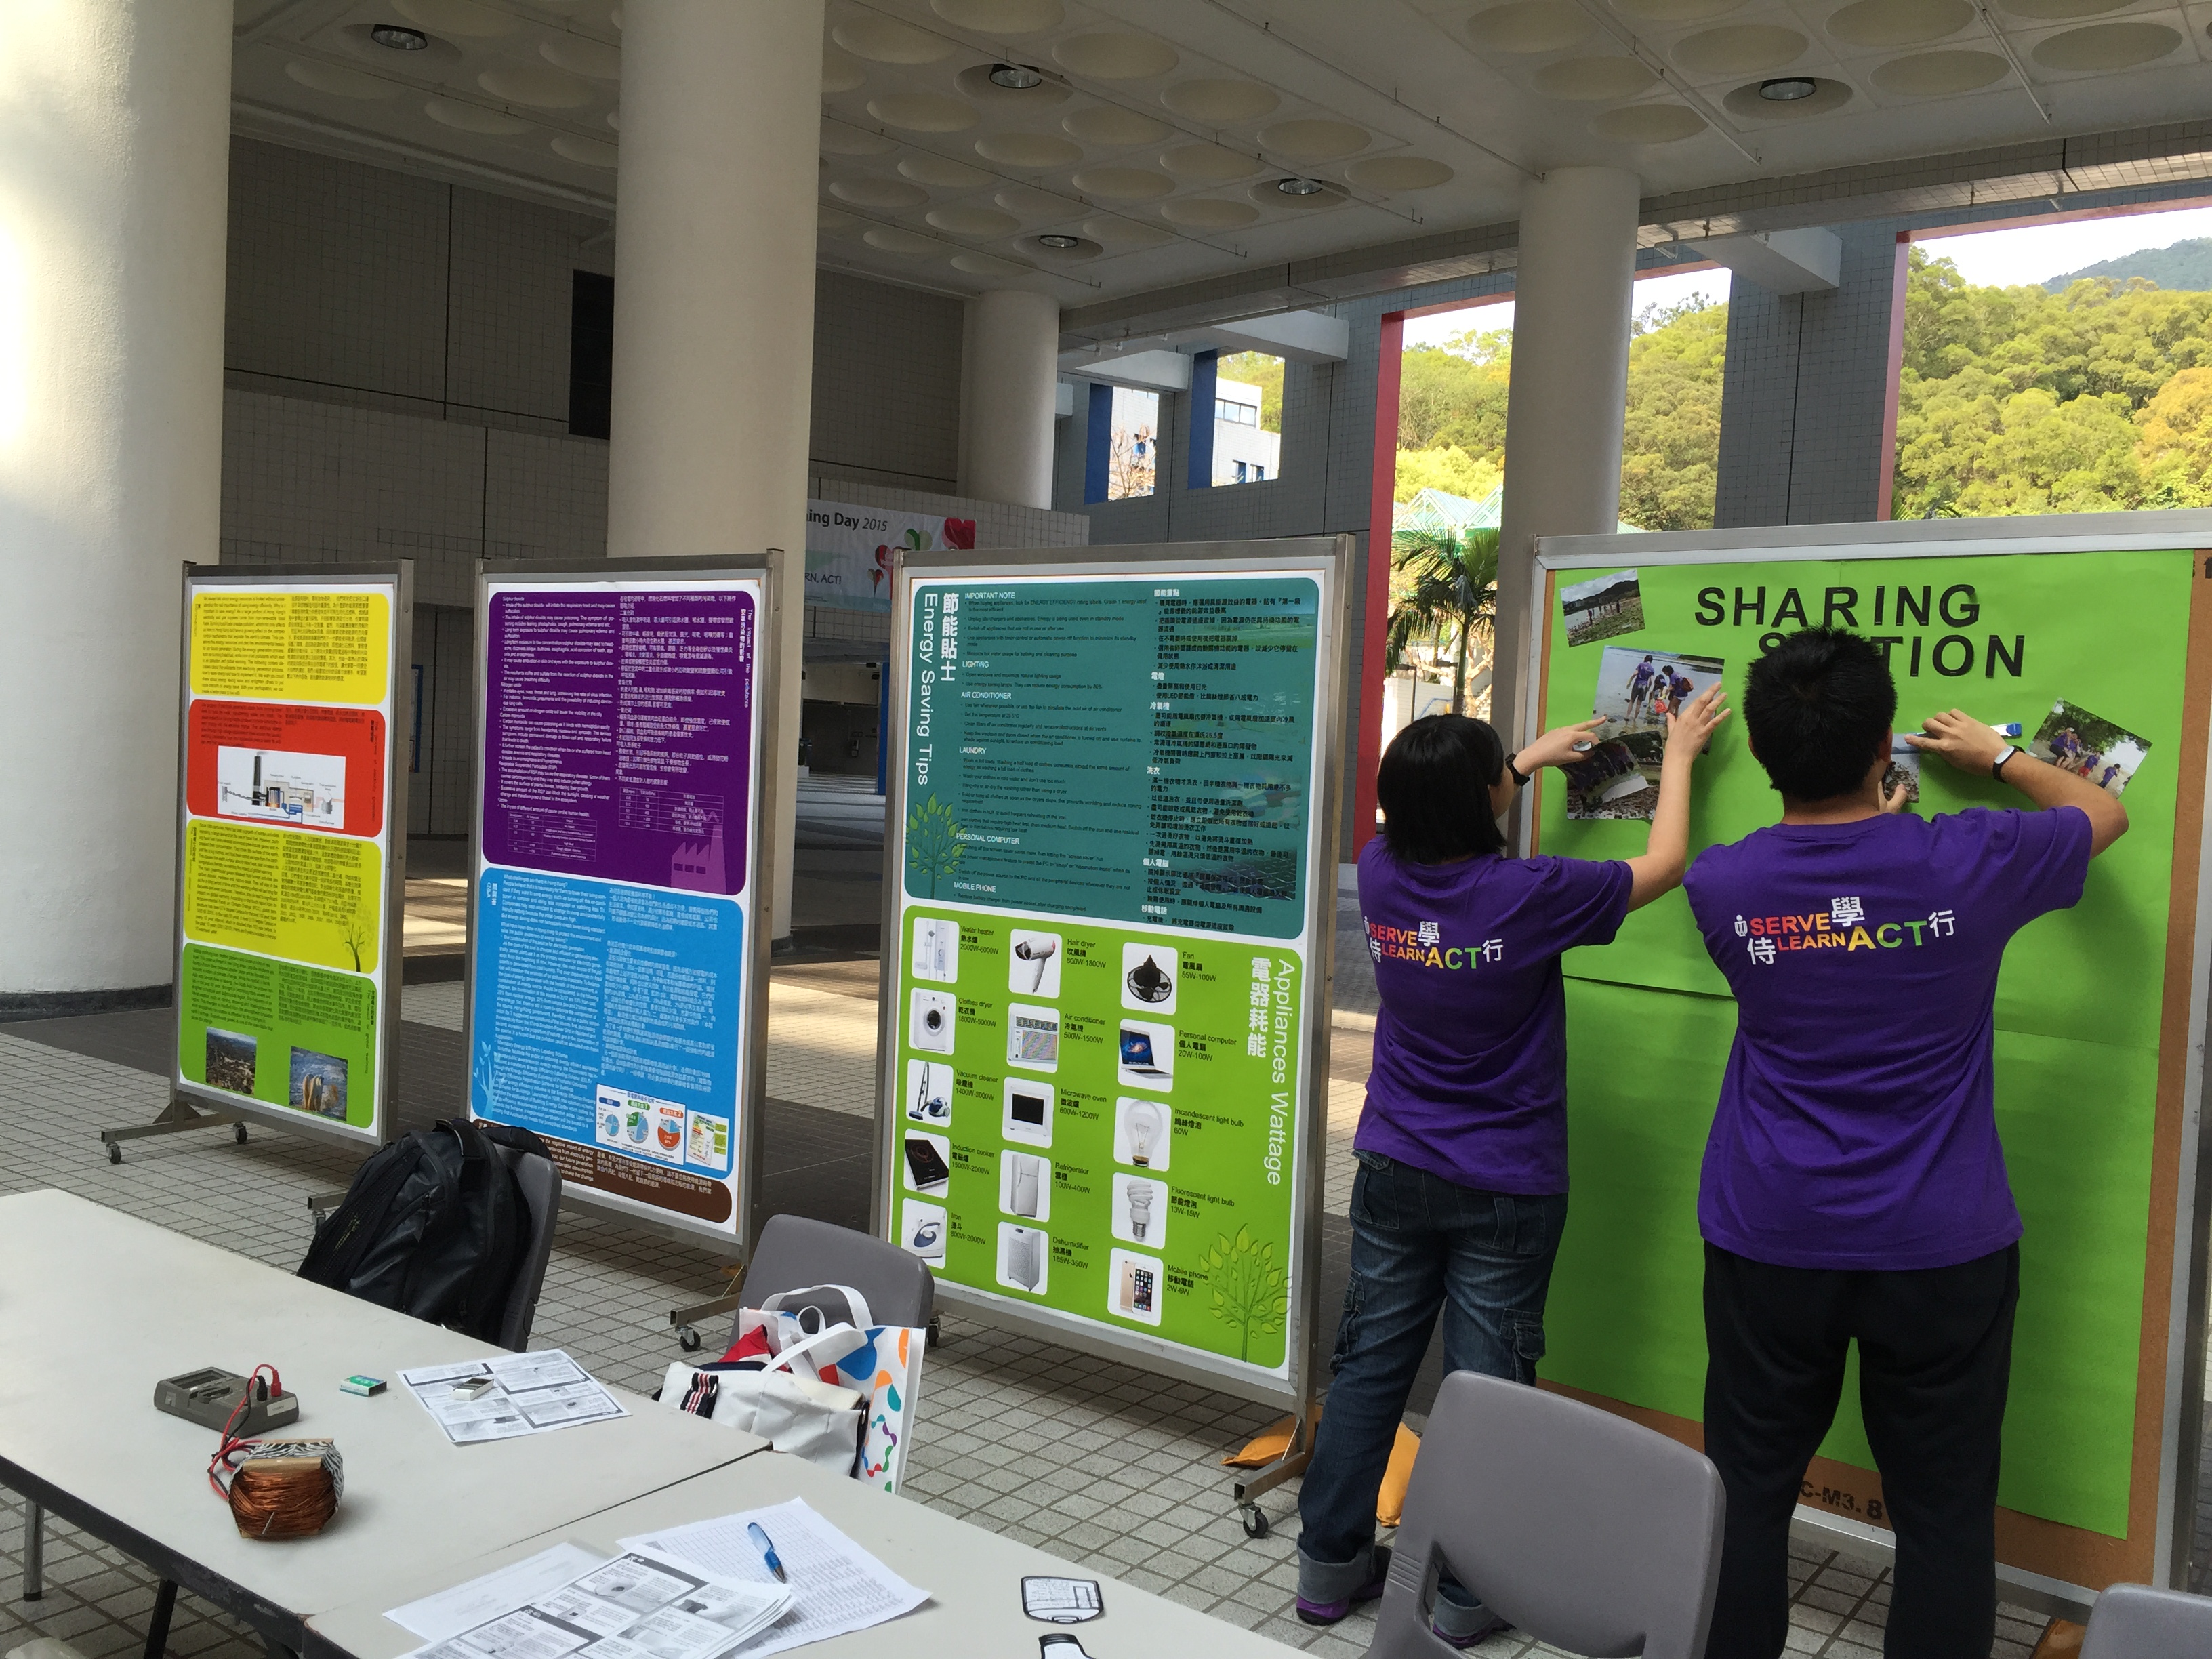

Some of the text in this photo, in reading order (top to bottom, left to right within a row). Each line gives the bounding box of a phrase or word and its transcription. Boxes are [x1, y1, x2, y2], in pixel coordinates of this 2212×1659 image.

[807, 510, 888, 531] ing Day 2015
[821, 575, 842, 585] ACT!
[1695, 584, 1980, 628] SHARING
[941, 592, 959, 682] 節能貼士
[915, 593, 938, 785] Energy Saving Tips
[1149, 701, 1170, 710] 冷氣機
[1146, 766, 1160, 775] 洗衣
[956, 833, 1020, 844] PERSONAL COMPUTER
[954, 882, 996, 893] MOBILE PHONE
[1831, 896, 1864, 927] 學
[1750, 912, 1832, 935] SERVE
[1928, 909, 1955, 937] 行
[961, 926, 994, 936] Water heater
[1370, 922, 1418, 946] SERVE
[1418, 921, 1439, 947] 學
[1777, 920, 1927, 951] LEARN ACT
[960, 943, 999, 955] 2000W-6000W
[1067, 949, 1086, 957] 吹風機
[1183, 951, 1195, 960] Fan
[1482, 939, 1504, 962] 行
[1747, 937, 1776, 965] 侍
[1067, 958, 1106, 968] 800W-1800W
[1381, 943, 1481, 970] LEARN ACT
[1182, 962, 1202, 972] 電風扇
[1182, 972, 1217, 982] 55W-100W
[959, 998, 993, 1009] Clothes dryer
[1247, 956, 1271, 1058] 電器耗能
[1073, 1015, 1106, 1025] conditioner
[1065, 1022, 1084, 1032] 冷氣機
[1064, 1032, 1103, 1044] 500W-1500W
[1179, 1030, 1237, 1046] Personal computer
[1179, 1040, 1206, 1052] 個人電腦
[1178, 1051, 1213, 1061] 20W-100W
[957, 1069, 998, 1083] Vacuum cleaner
[1263, 958, 1295, 1186] Appliances Wattage
[956, 1088, 994, 1101] 1400W-3000W
[1061, 1088, 1107, 1103] Microwave oven
[1059, 1108, 1099, 1120] 600W-1200W
[1175, 1107, 1244, 1128] Incandescent light bulb
[1174, 1128, 1189, 1136] 60W
[952, 1143, 995, 1158] Induction cooker
[952, 1162, 990, 1175] 1500W-2000W
[1055, 1162, 1089, 1175] Refrigerator
[1055, 1181, 1090, 1194] 100W-400W
[1171, 1186, 1235, 1208] Fluorescent light bulb
[951, 1212, 962, 1221] Iron
[1171, 1205, 1200, 1218] 13W-15W
[950, 1231, 986, 1245] 800W-2000W
[1052, 1236, 1089, 1250] Dehumidifier
[1052, 1256, 1088, 1269] 185W-350W
[1168, 1265, 1209, 1281] Mobile phone
[1167, 1274, 1194, 1288] 移動電話
[1167, 1284, 1190, 1296] 2W-6W
